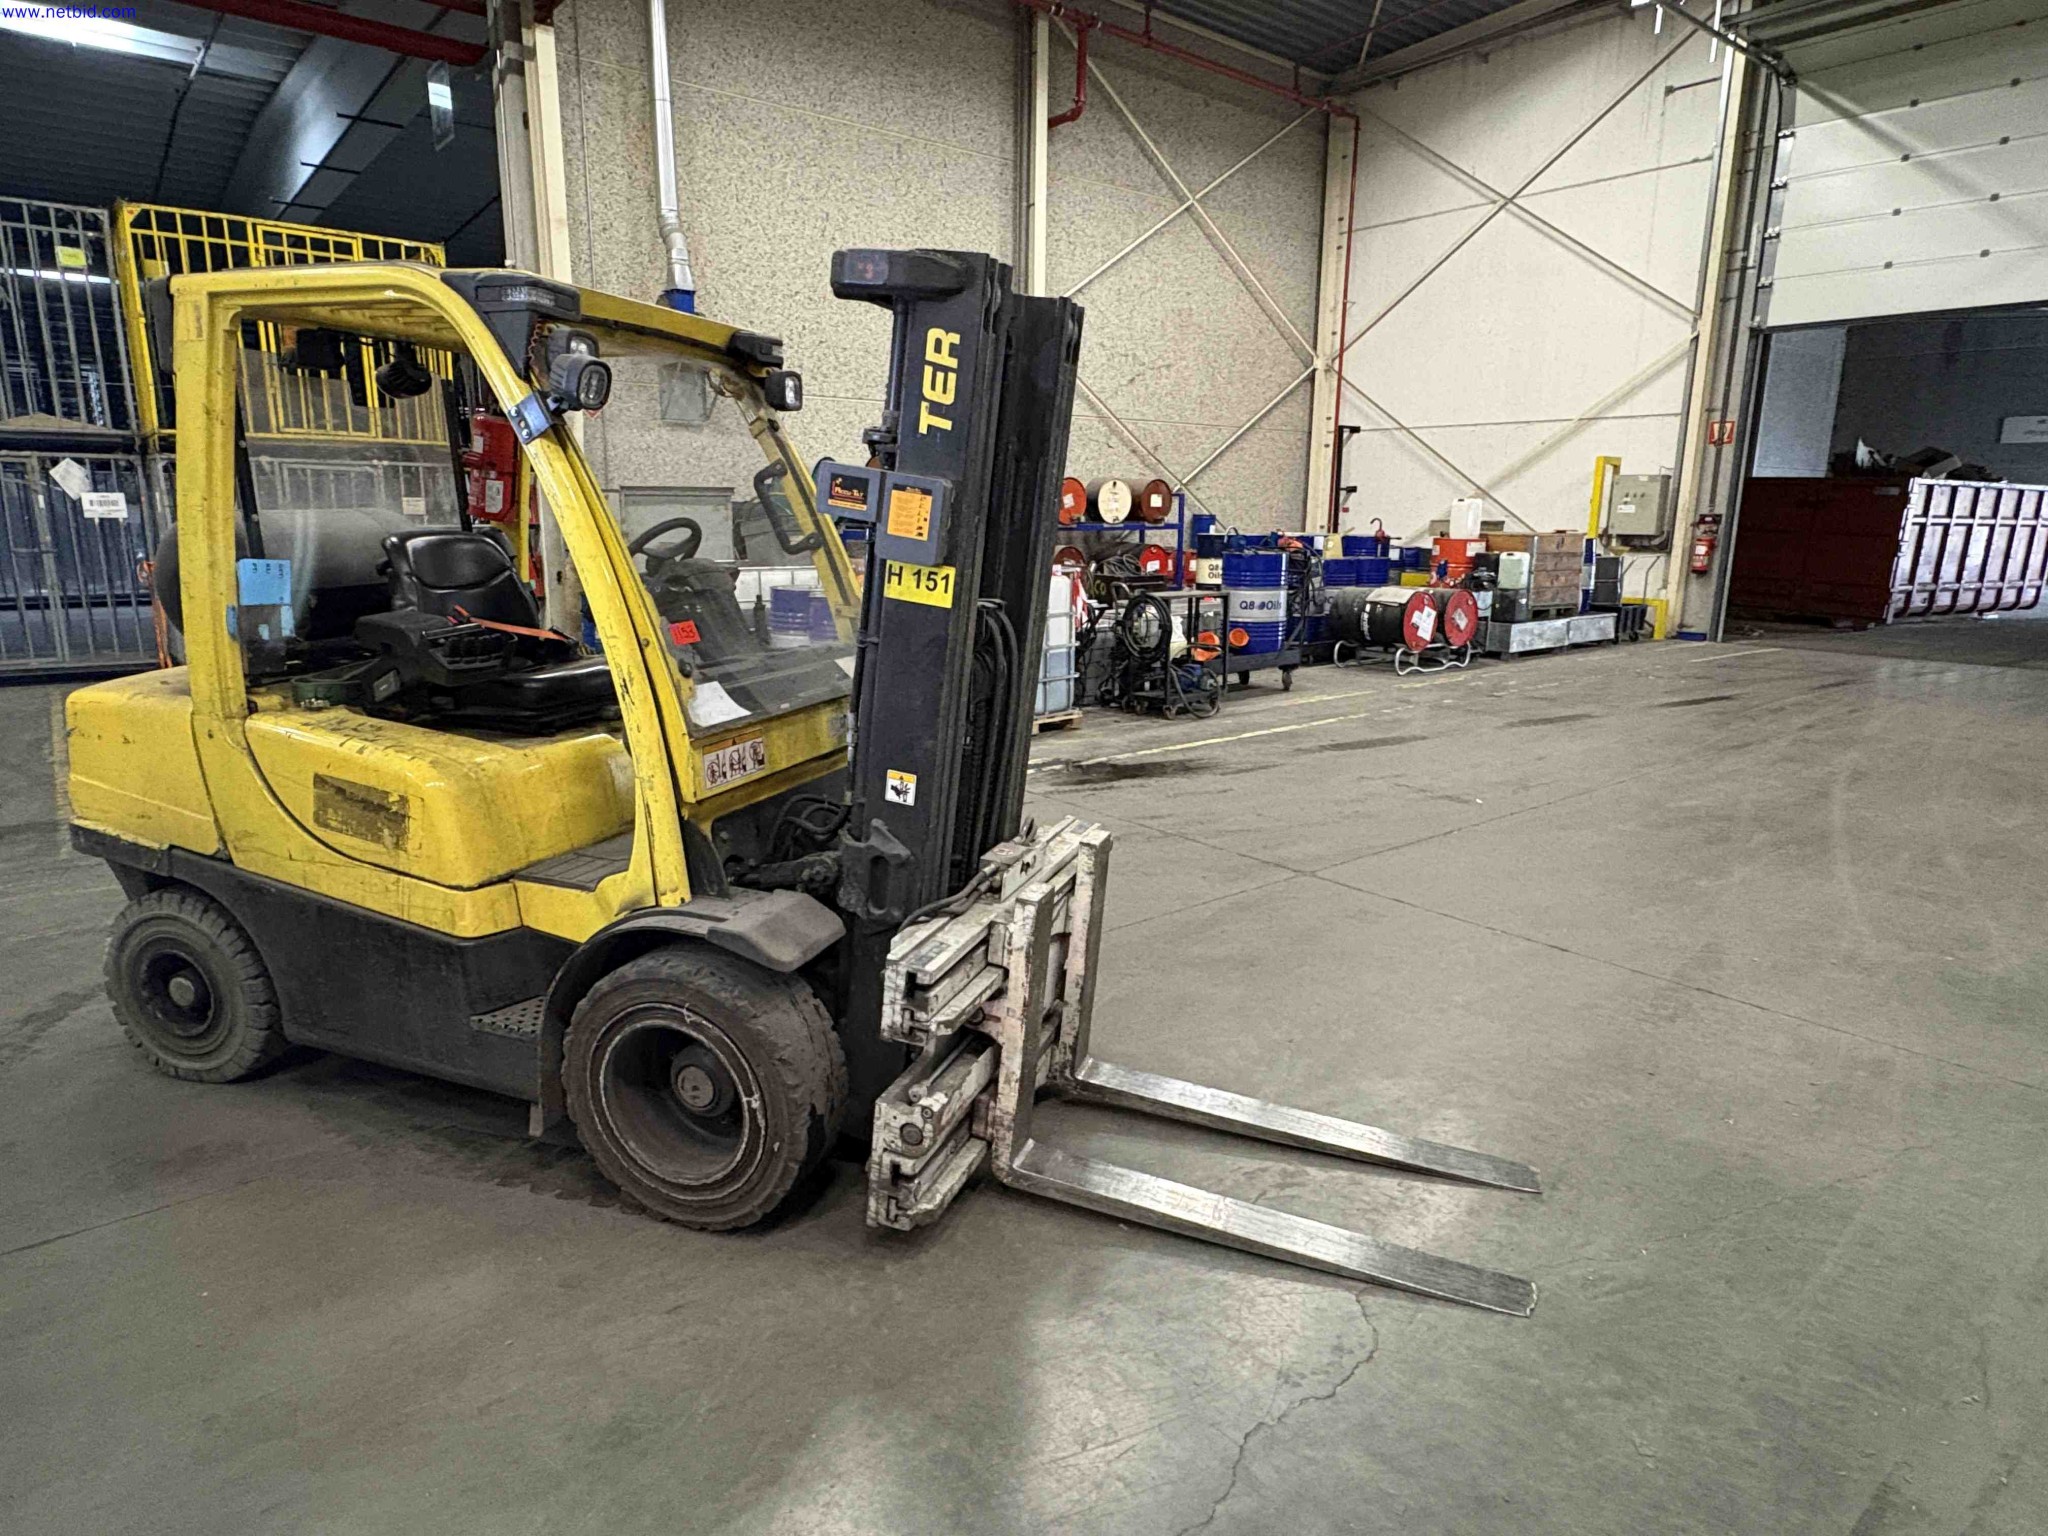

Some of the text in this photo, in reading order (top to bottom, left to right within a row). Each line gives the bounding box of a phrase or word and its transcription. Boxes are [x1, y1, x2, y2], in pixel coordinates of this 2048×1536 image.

[918, 328, 960, 435] TER
[887, 564, 950, 594] H 151
[1239, 600, 1255, 610] Q8
